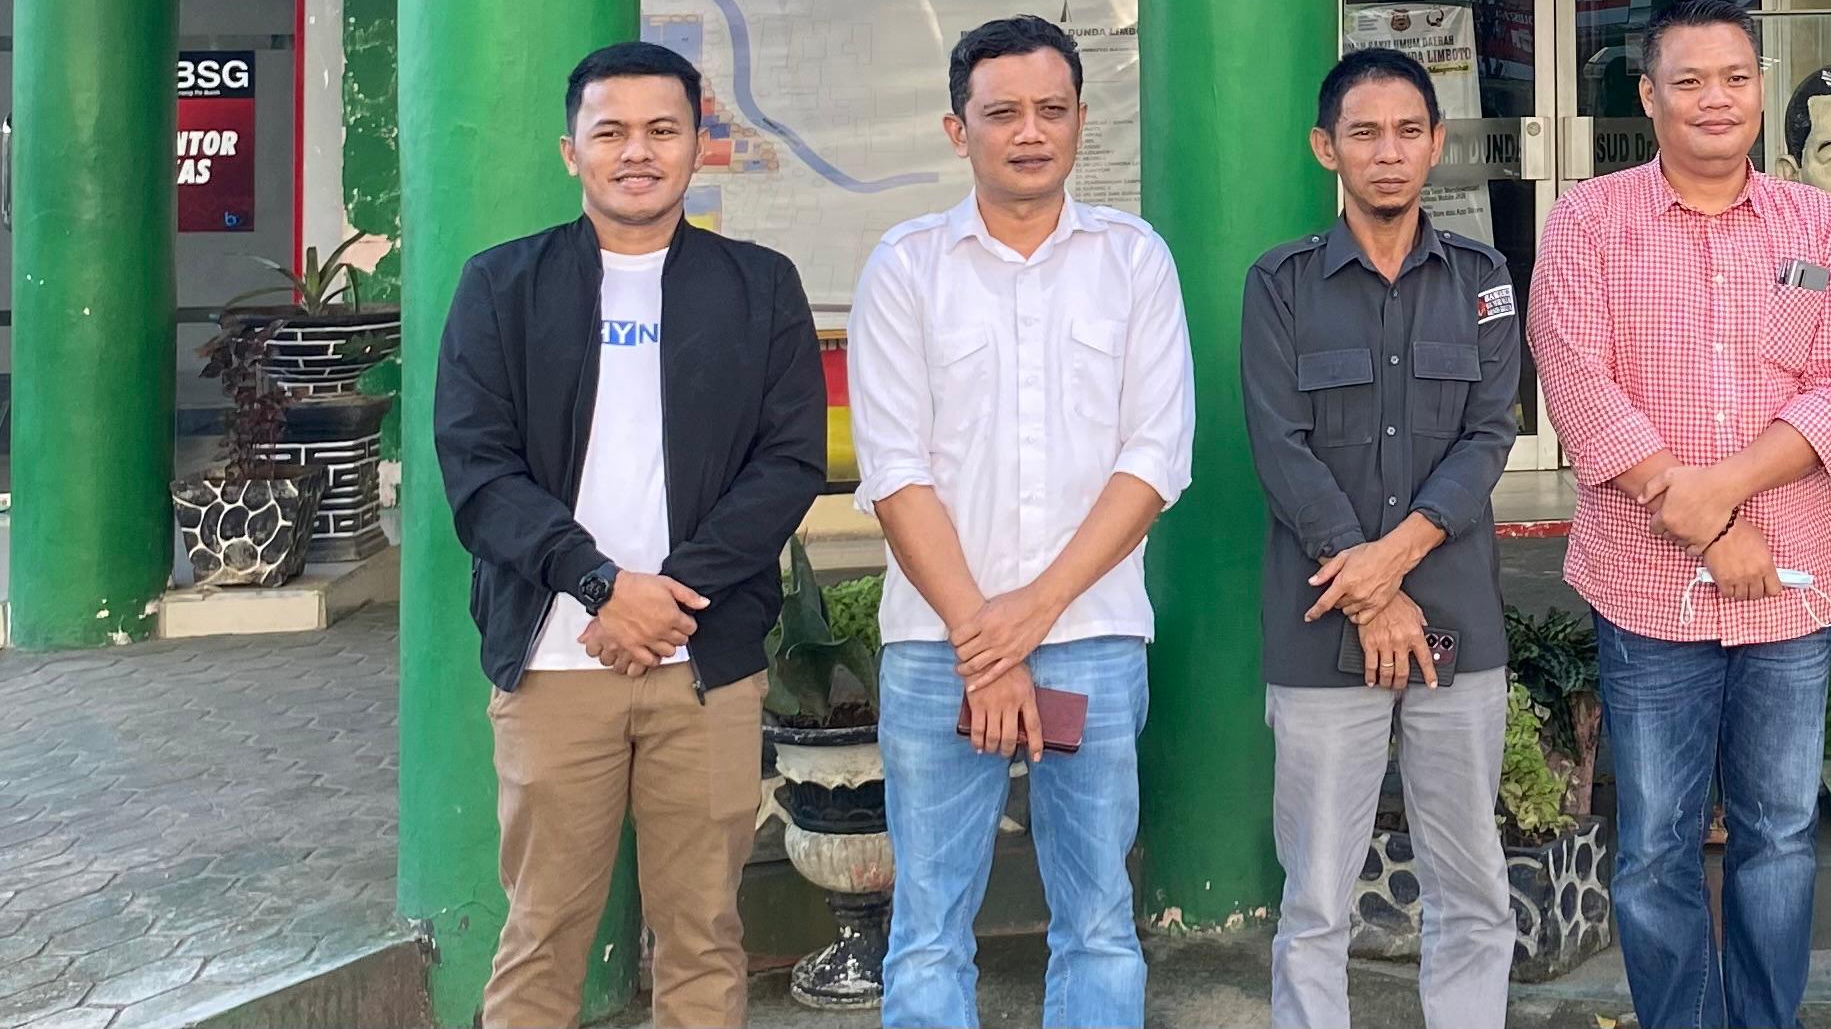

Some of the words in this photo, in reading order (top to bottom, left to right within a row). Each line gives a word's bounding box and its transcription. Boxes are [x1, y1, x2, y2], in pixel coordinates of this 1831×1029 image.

[177, 130, 239, 157] NTOR
[1594, 132, 1629, 163] SUD
[177, 158, 212, 185] AS
